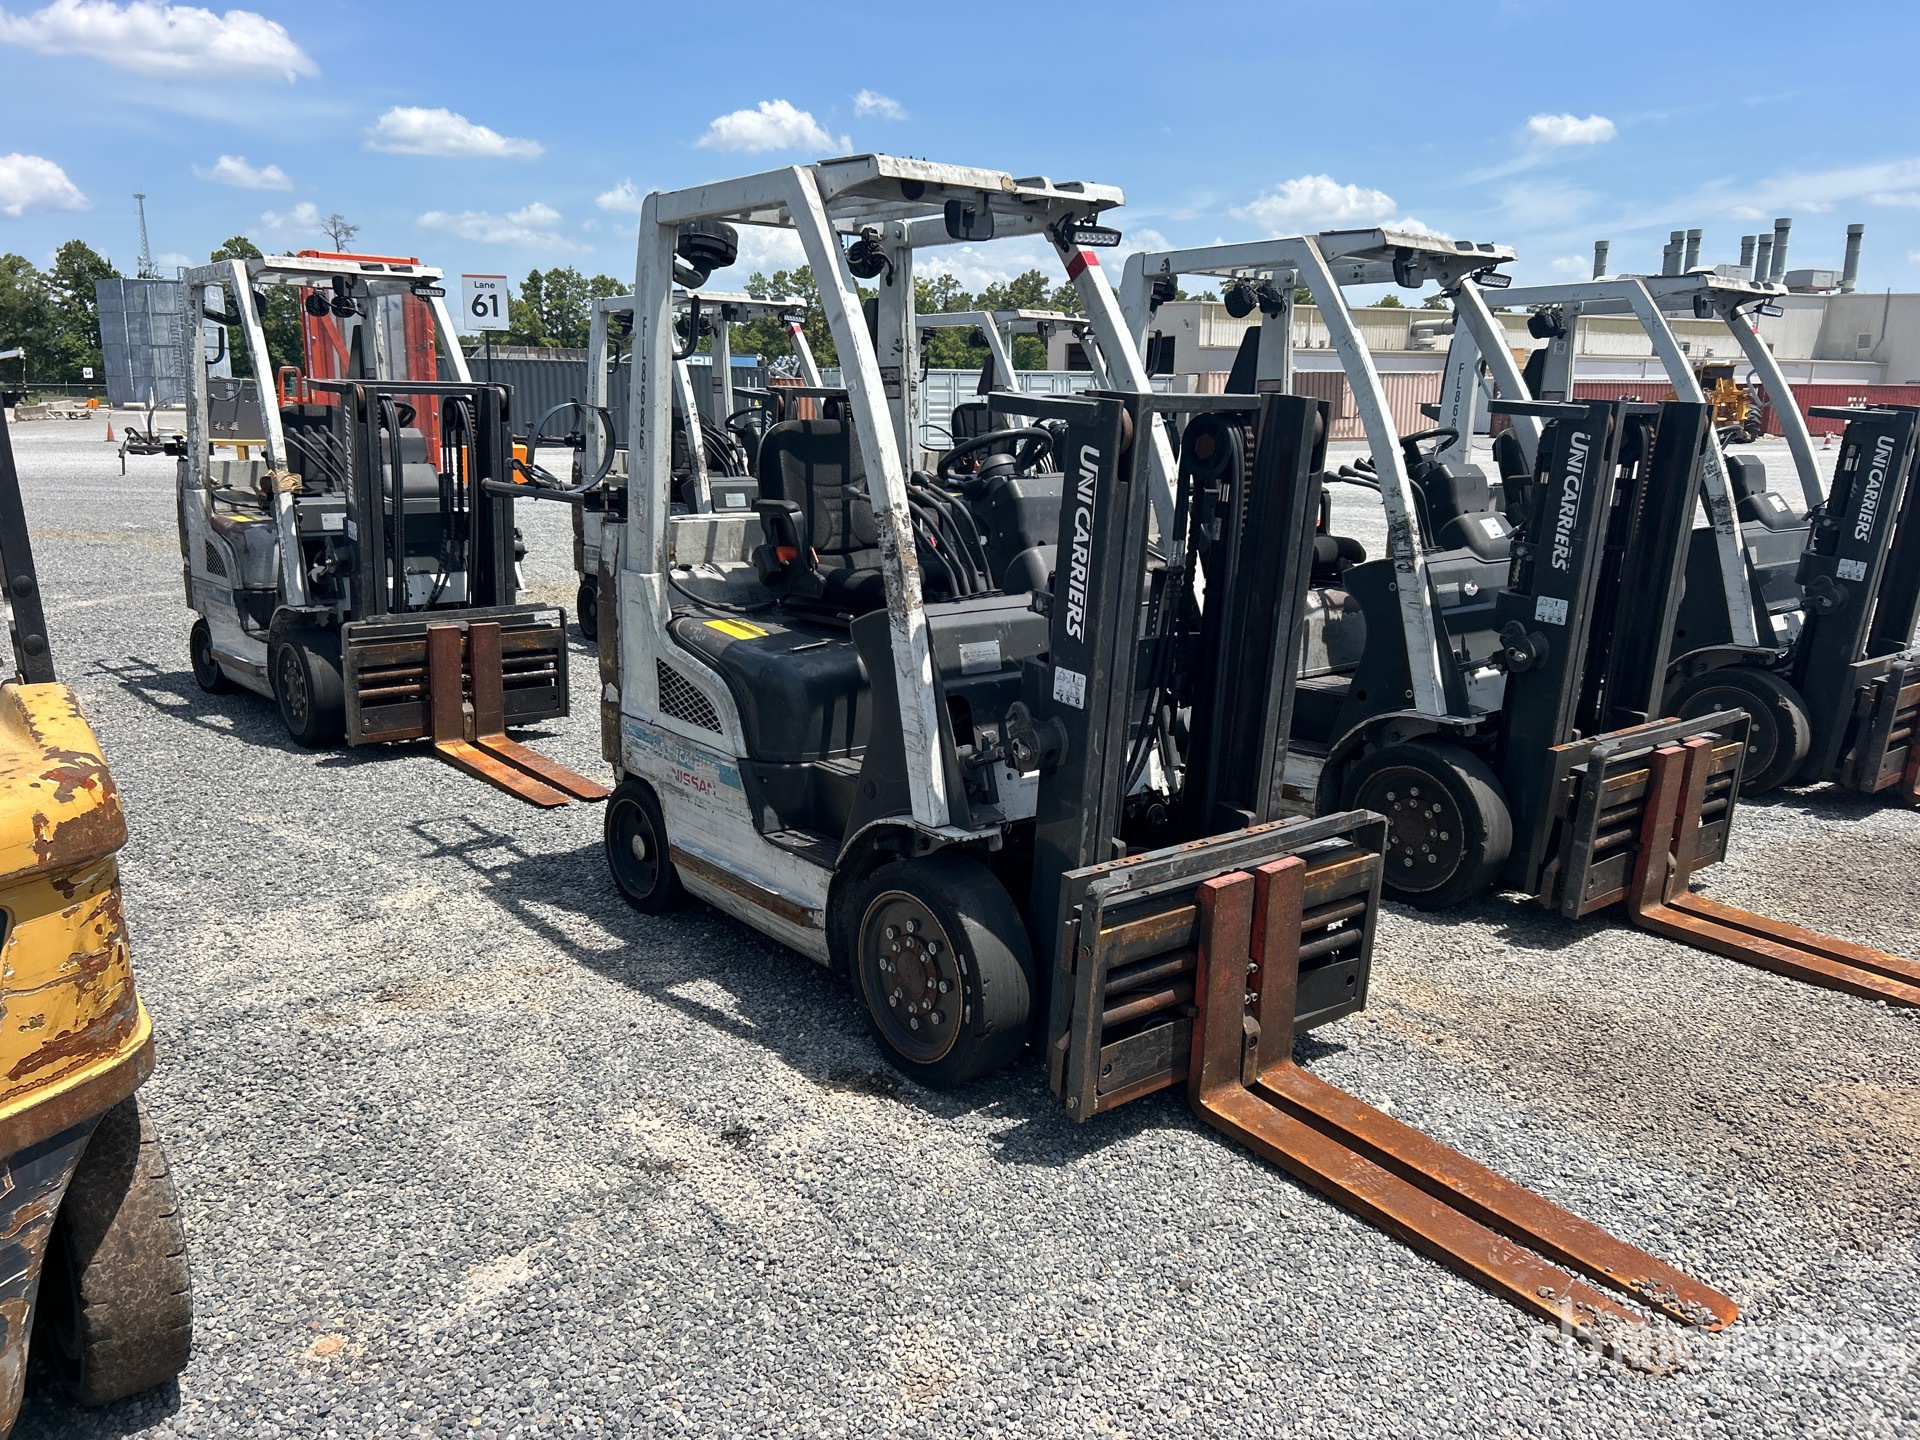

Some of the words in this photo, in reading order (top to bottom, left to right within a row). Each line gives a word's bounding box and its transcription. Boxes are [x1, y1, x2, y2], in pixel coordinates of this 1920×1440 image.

[471, 293, 499, 318] 61
[473, 281, 496, 289] Lane
[639, 316, 648, 450] FL8686
[1450, 362, 1465, 428] FL868
